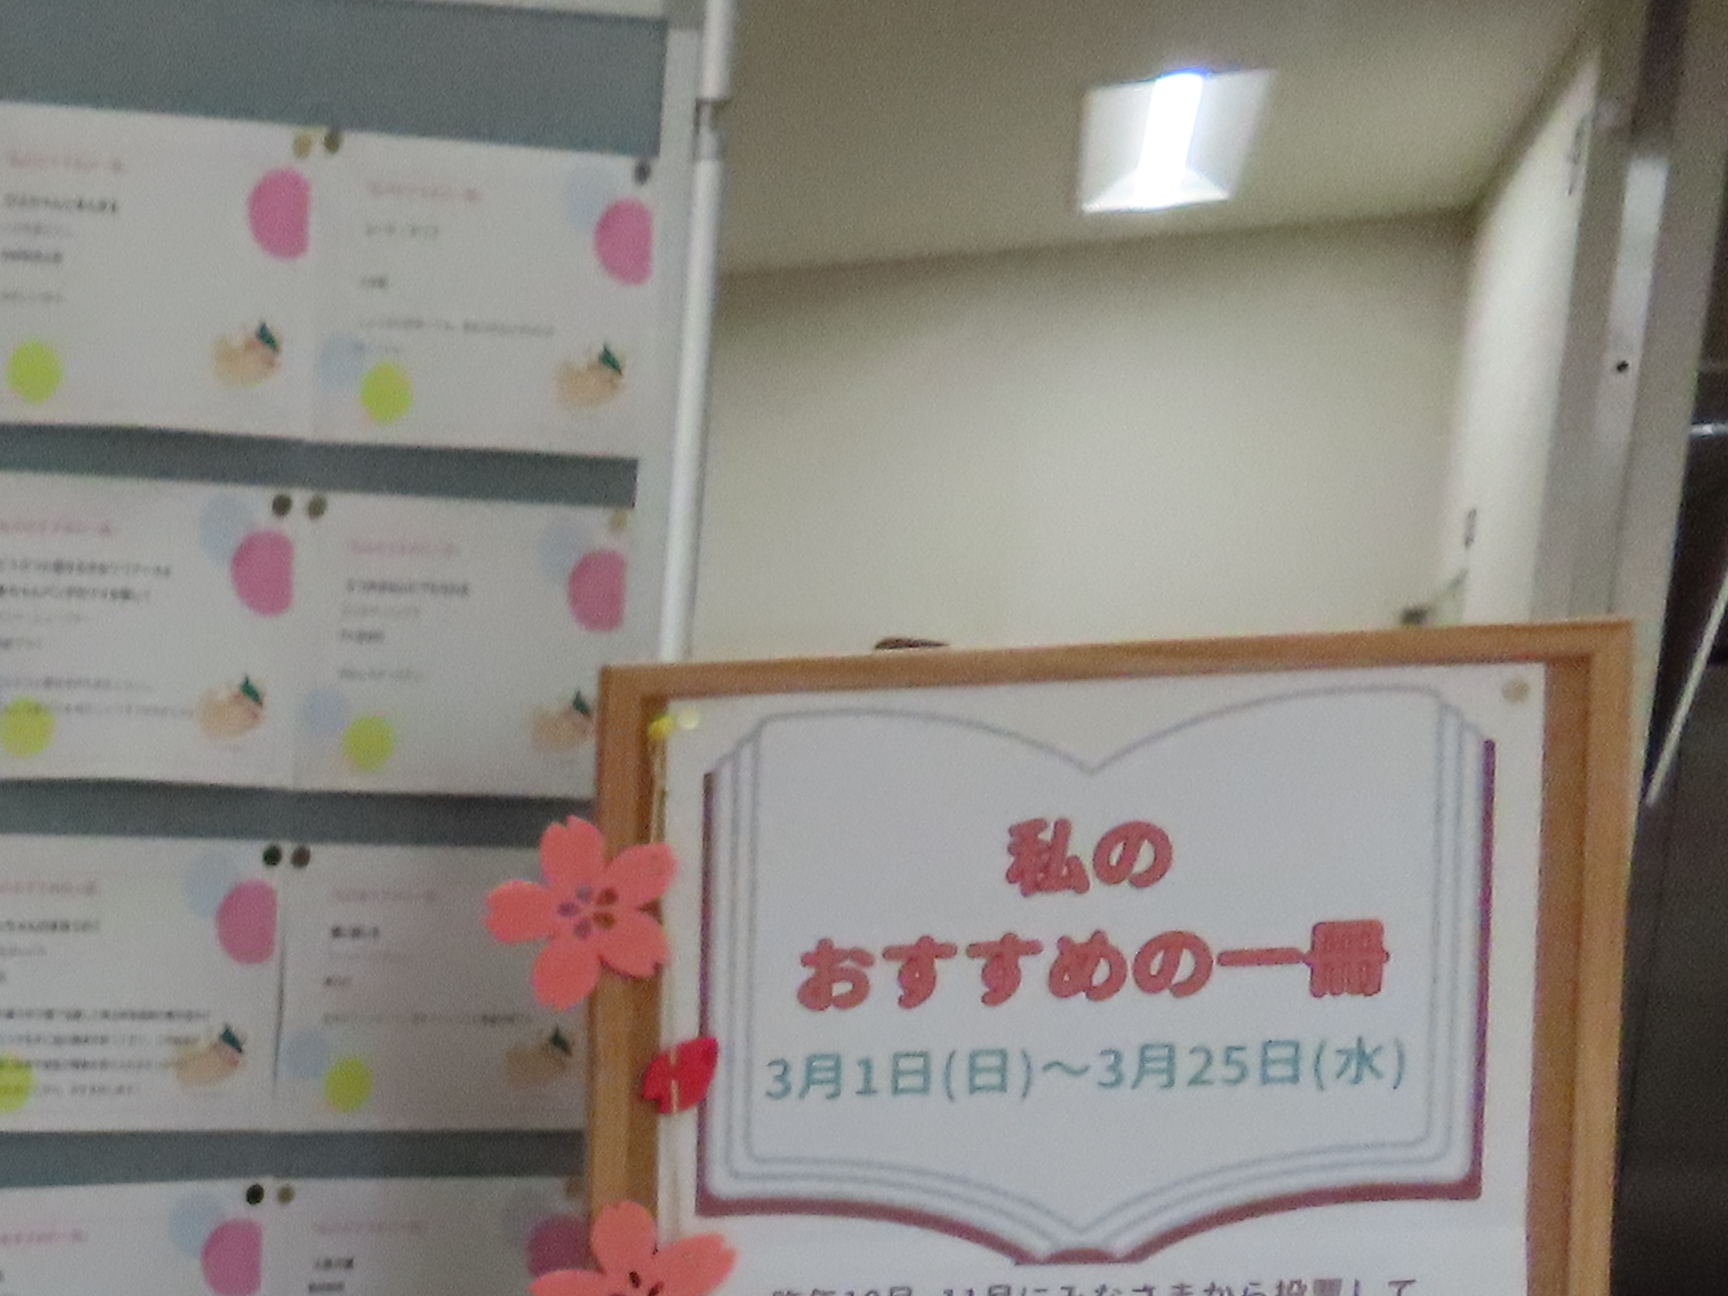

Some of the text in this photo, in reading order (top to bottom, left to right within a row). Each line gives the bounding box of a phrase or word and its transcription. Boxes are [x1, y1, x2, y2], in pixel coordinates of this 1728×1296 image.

[1005, 817, 1174, 900] 私の
[796, 917, 1388, 1012] おすすめの一冊
